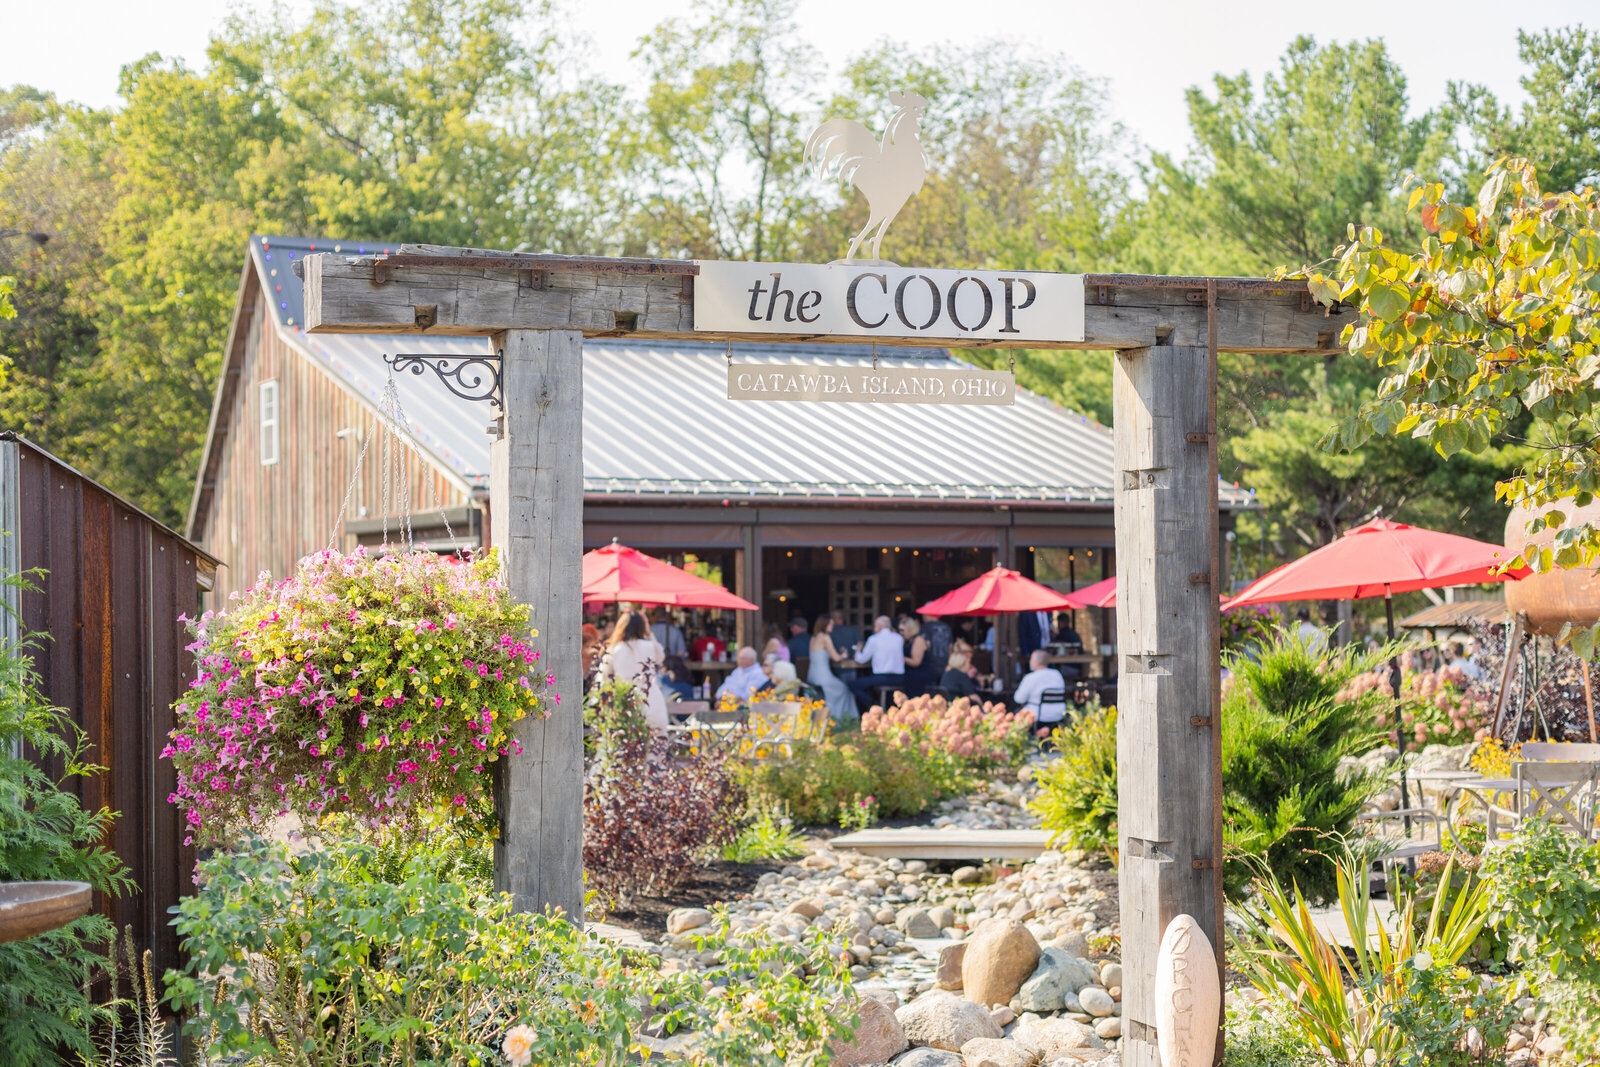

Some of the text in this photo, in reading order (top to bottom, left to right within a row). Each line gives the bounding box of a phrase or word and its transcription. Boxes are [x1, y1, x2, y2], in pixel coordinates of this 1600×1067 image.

[747, 272, 1037, 334] the COOP
[737, 373, 1007, 398] CATAWBA ISLAND, OHIO
